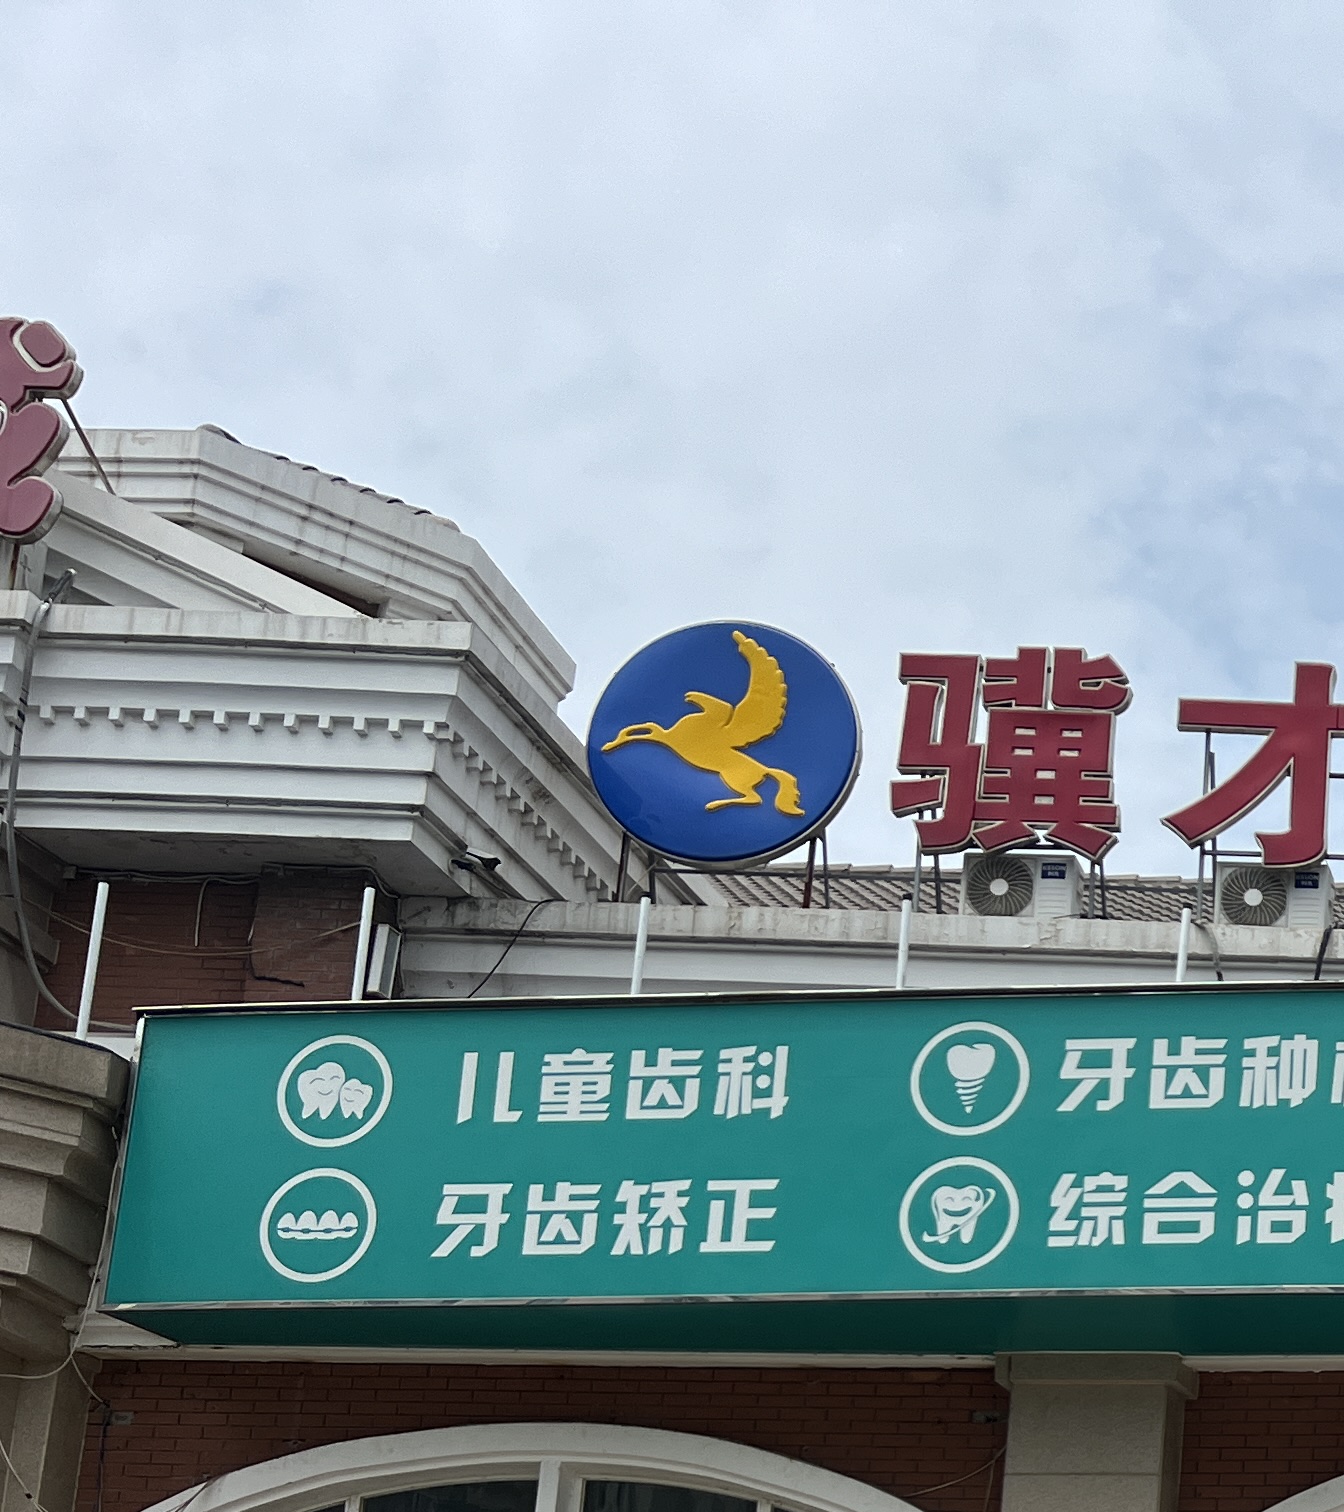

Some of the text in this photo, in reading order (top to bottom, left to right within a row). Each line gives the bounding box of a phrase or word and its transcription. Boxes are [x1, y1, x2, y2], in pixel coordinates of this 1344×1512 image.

[455, 1044, 791, 1125] 儿童齿科
[430, 1178, 781, 1257] 牙齿矫正
